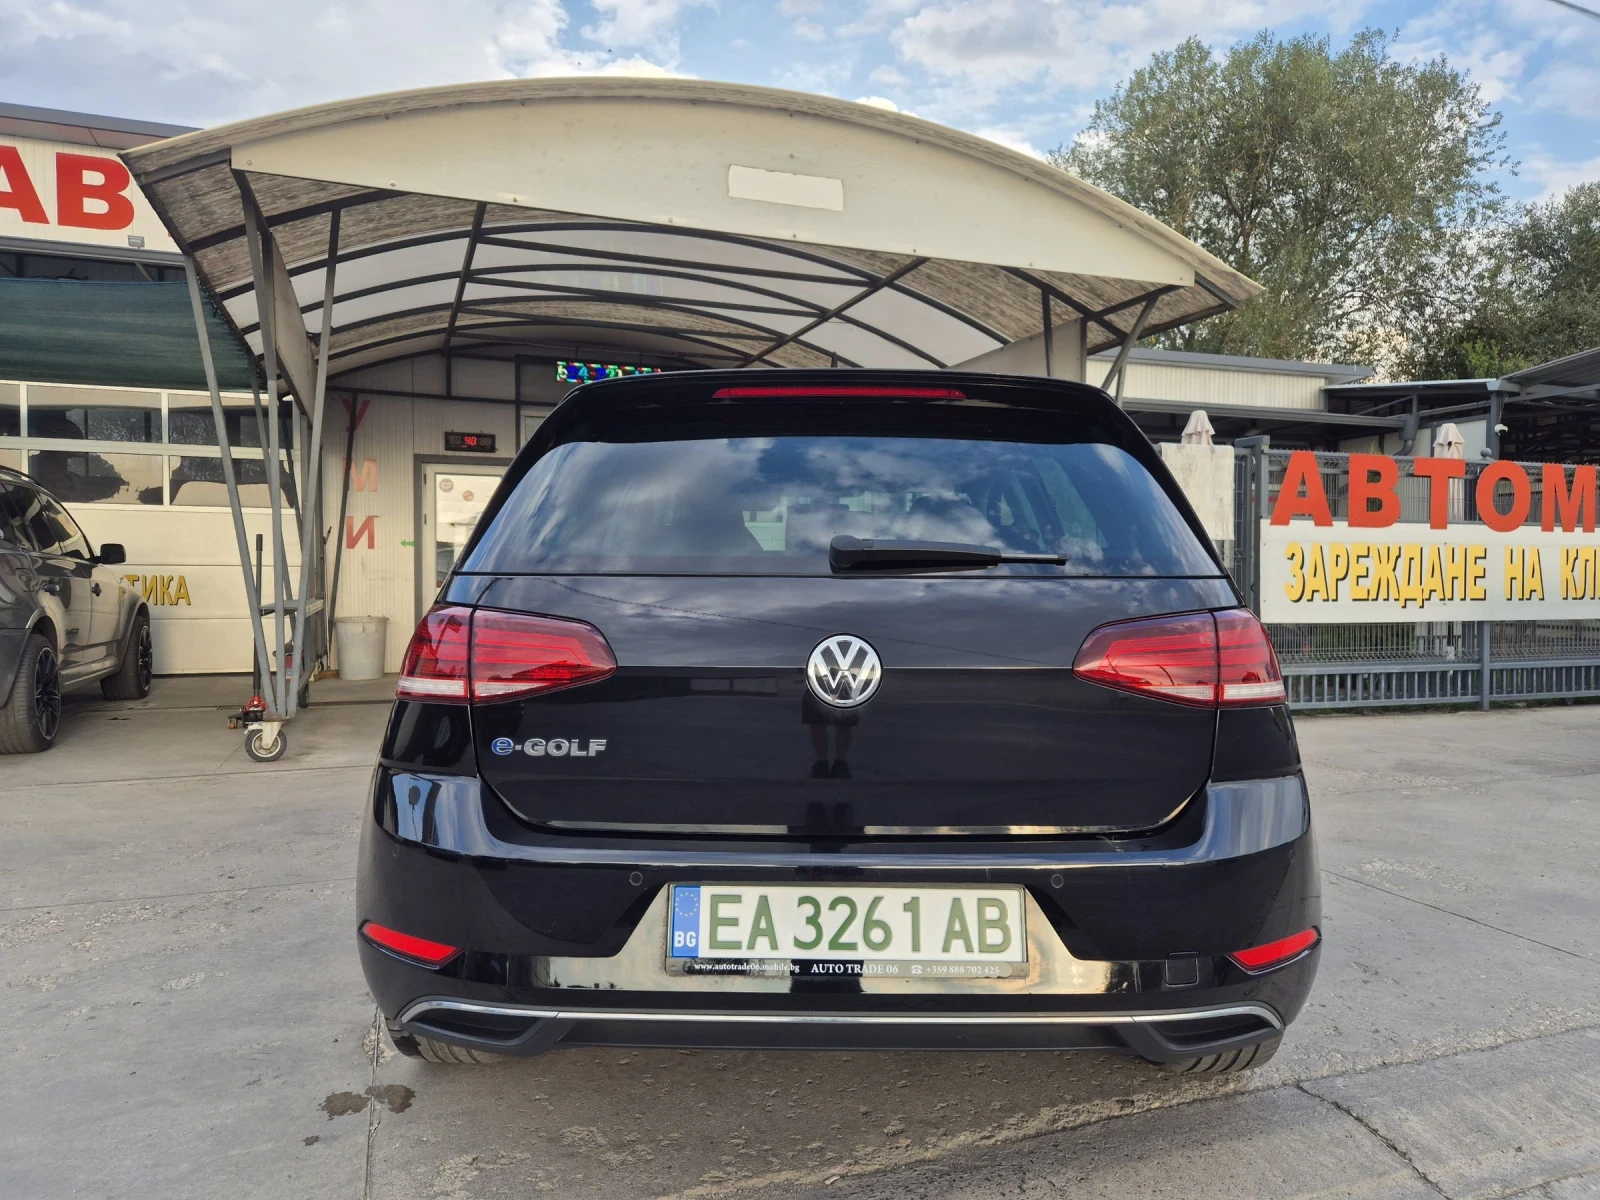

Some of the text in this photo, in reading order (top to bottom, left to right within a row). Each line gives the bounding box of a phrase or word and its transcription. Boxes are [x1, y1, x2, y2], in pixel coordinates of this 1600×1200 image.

[0, 145, 172, 237] АВ
[1270, 450, 1596, 533] АВТОМ
[1284, 541, 1600, 608] ЗАРЕЖДАНЕ НА КЛ
[491, 737, 608, 757] e-GOLF
[709, 894, 1013, 954] EA 3261 AB
[674, 931, 698, 949] BG
[694, 962, 801, 973] www.autotrade06.mobile.bg
[811, 963, 899, 974] AUTO TRADE 06
[925, 966, 1000, 975] +359 888 702 425
